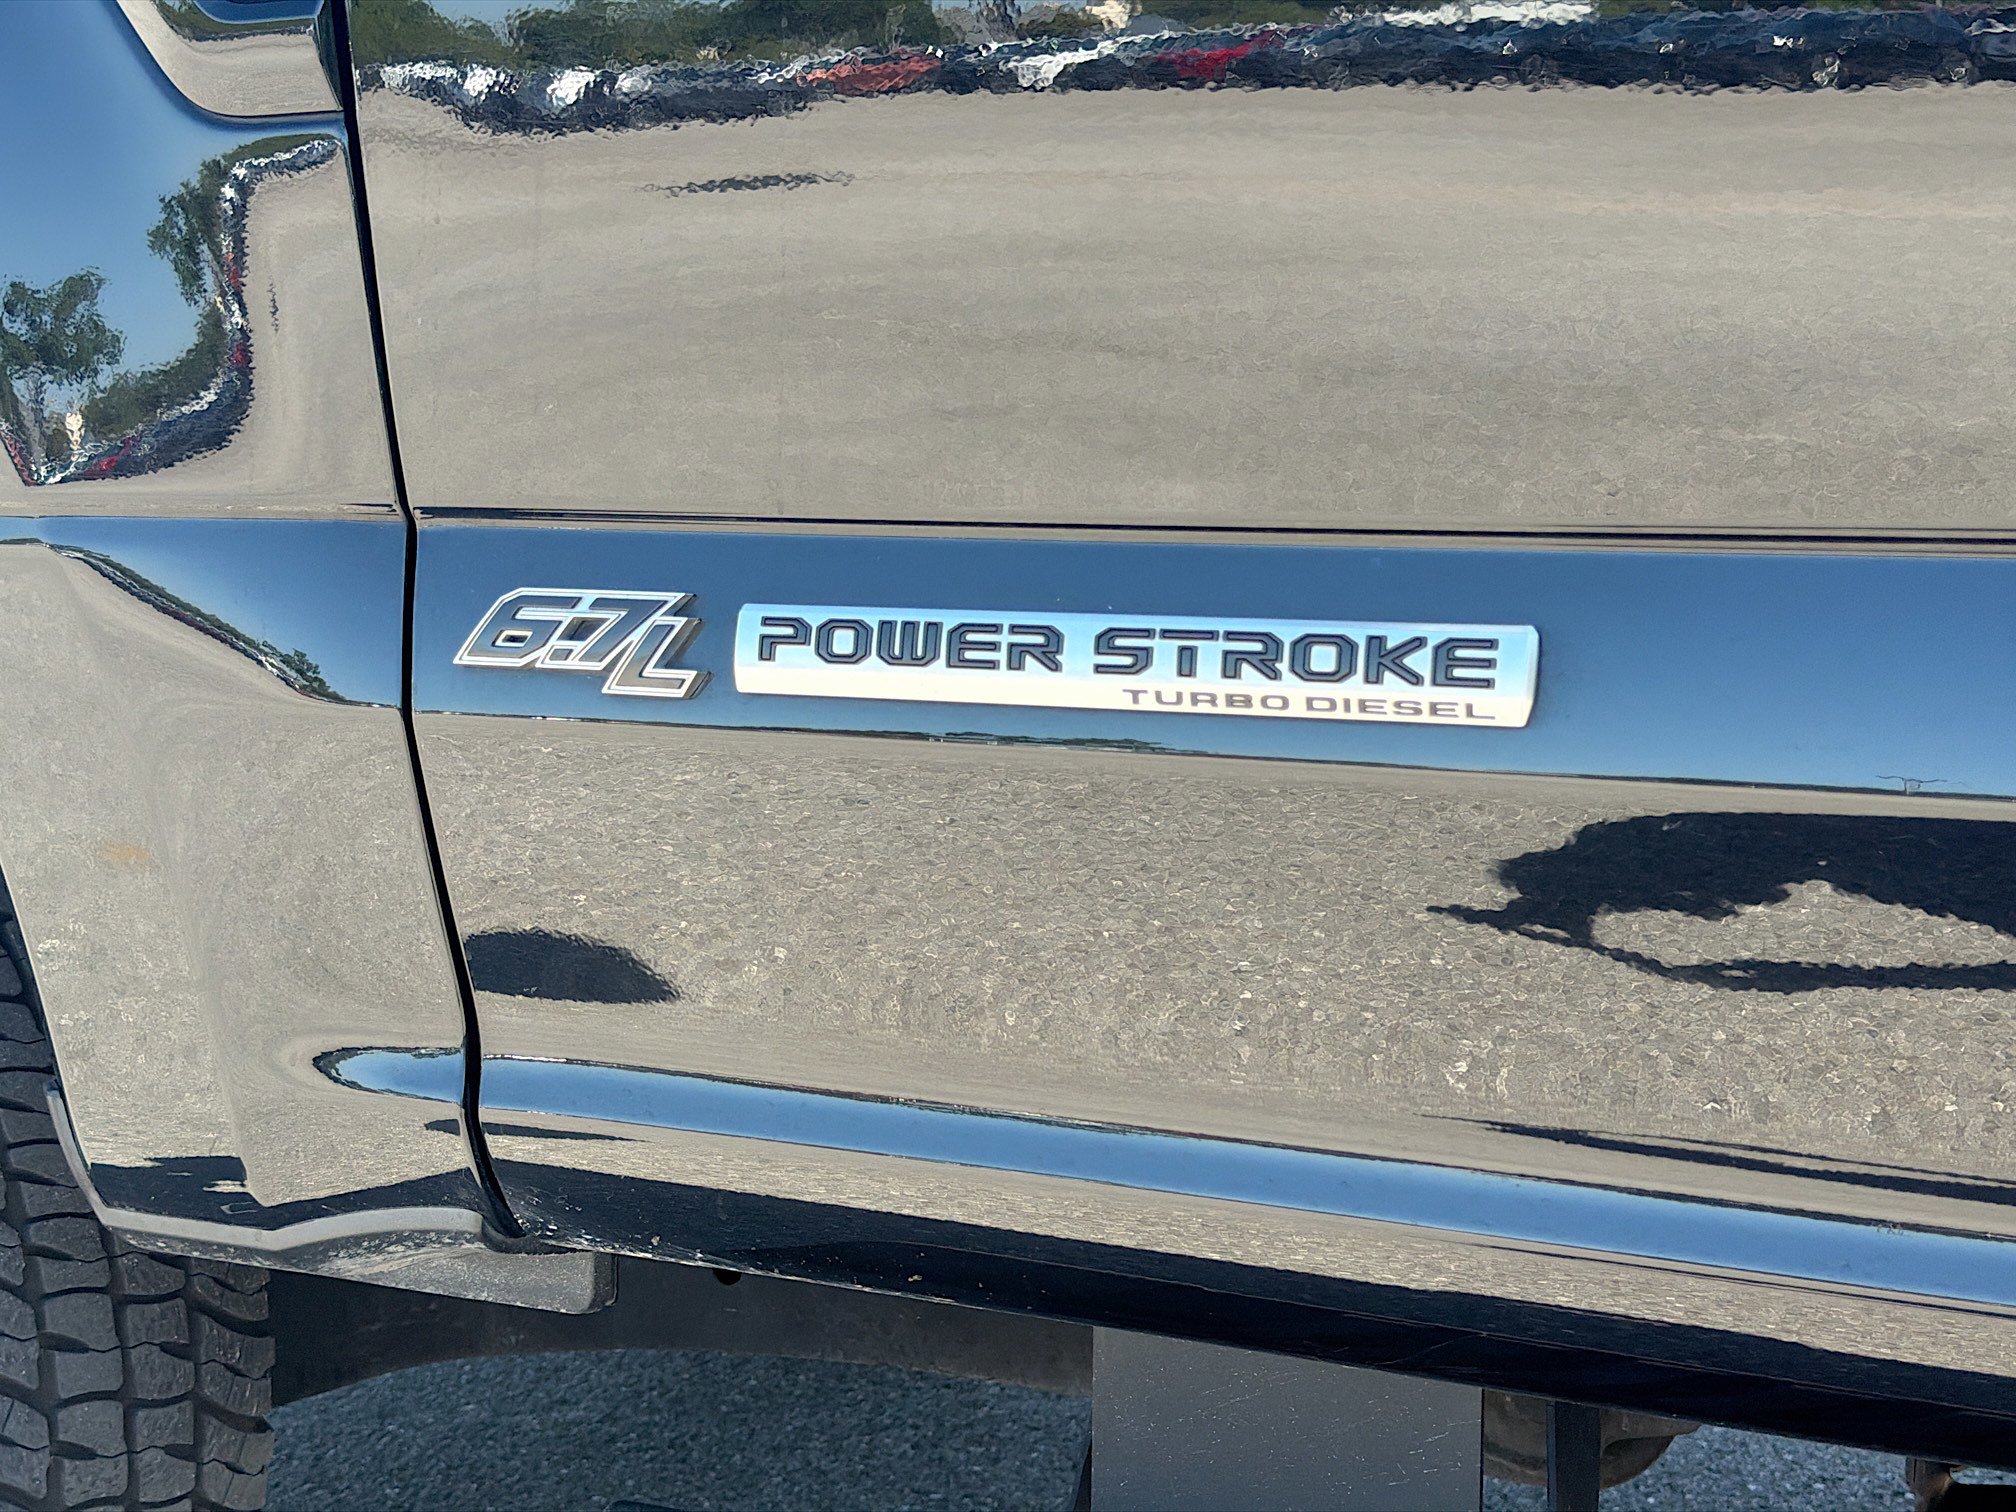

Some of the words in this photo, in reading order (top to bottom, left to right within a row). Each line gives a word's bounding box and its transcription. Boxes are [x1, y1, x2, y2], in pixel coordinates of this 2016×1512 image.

[453, 587, 702, 698] 6.7L
[758, 615, 1064, 672] POWER
[1093, 627, 1499, 689] STROKE
[1122, 689, 1290, 712] TURBO
[1306, 697, 1496, 720] DIESEL
